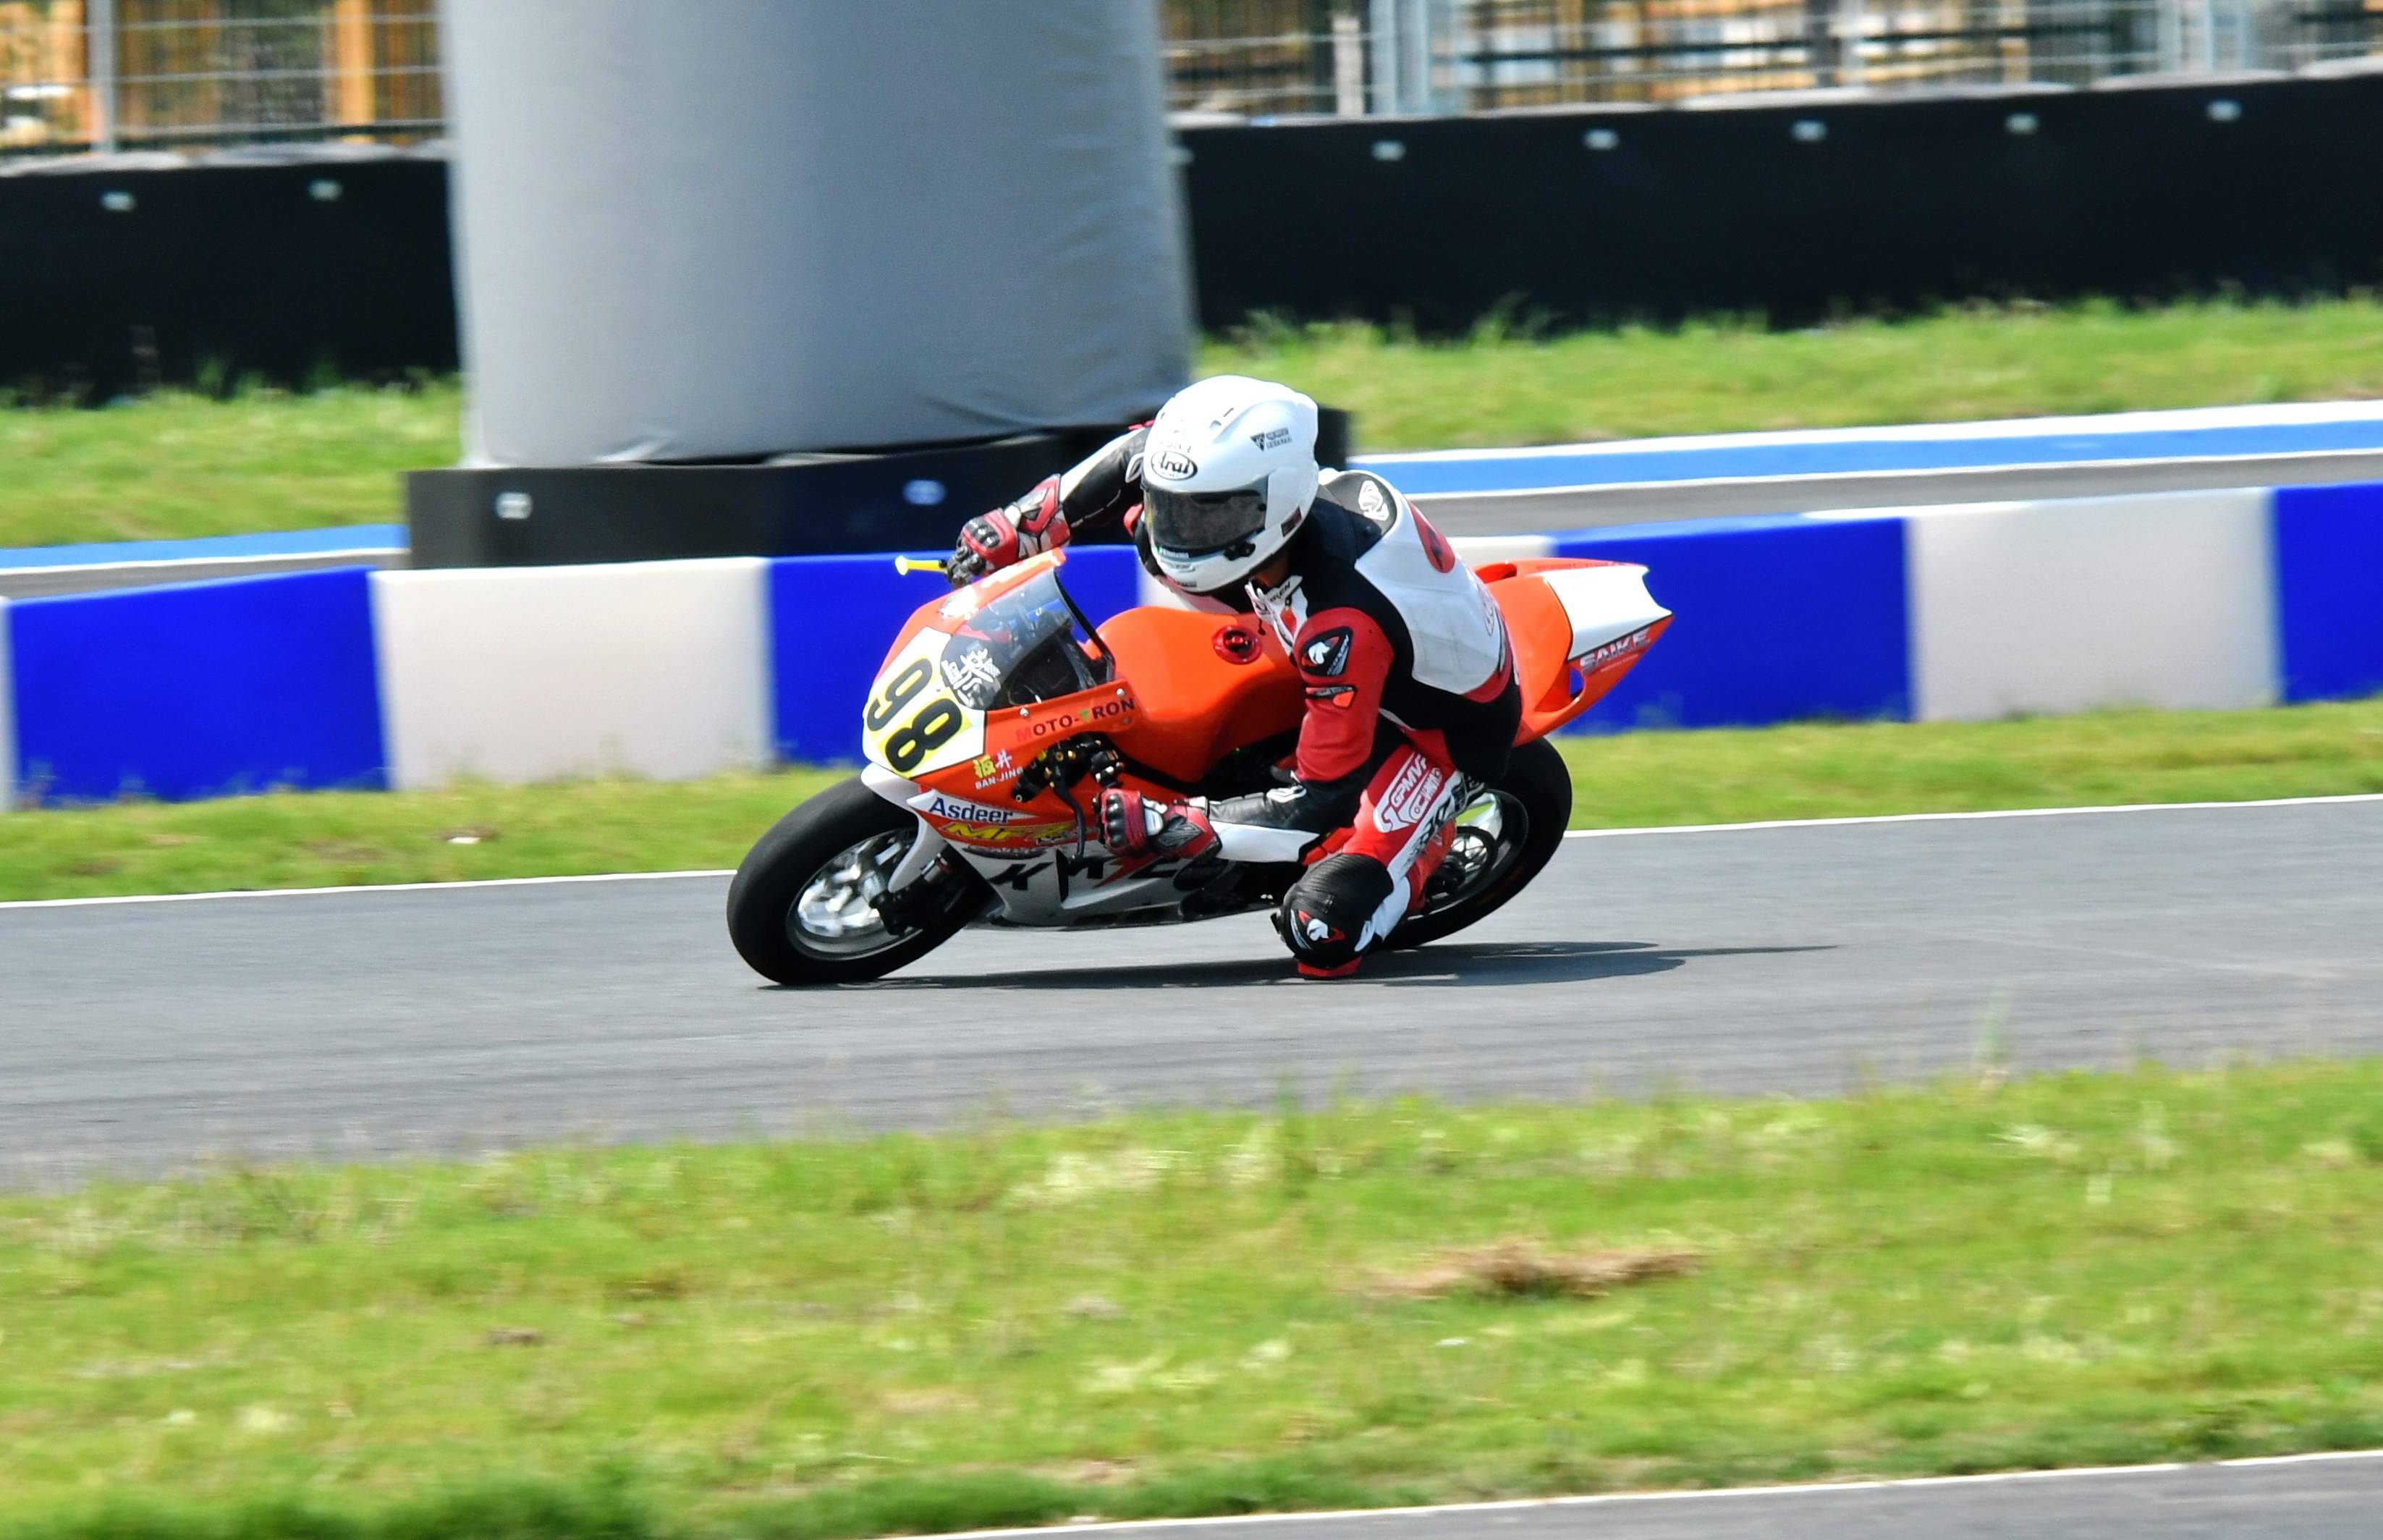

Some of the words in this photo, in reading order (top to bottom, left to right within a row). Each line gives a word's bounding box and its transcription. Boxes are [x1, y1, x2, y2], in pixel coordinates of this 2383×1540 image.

[1579, 627, 1651, 675] SAIKE
[866, 658, 963, 773] 98
[929, 797, 1014, 824] Asdeer
